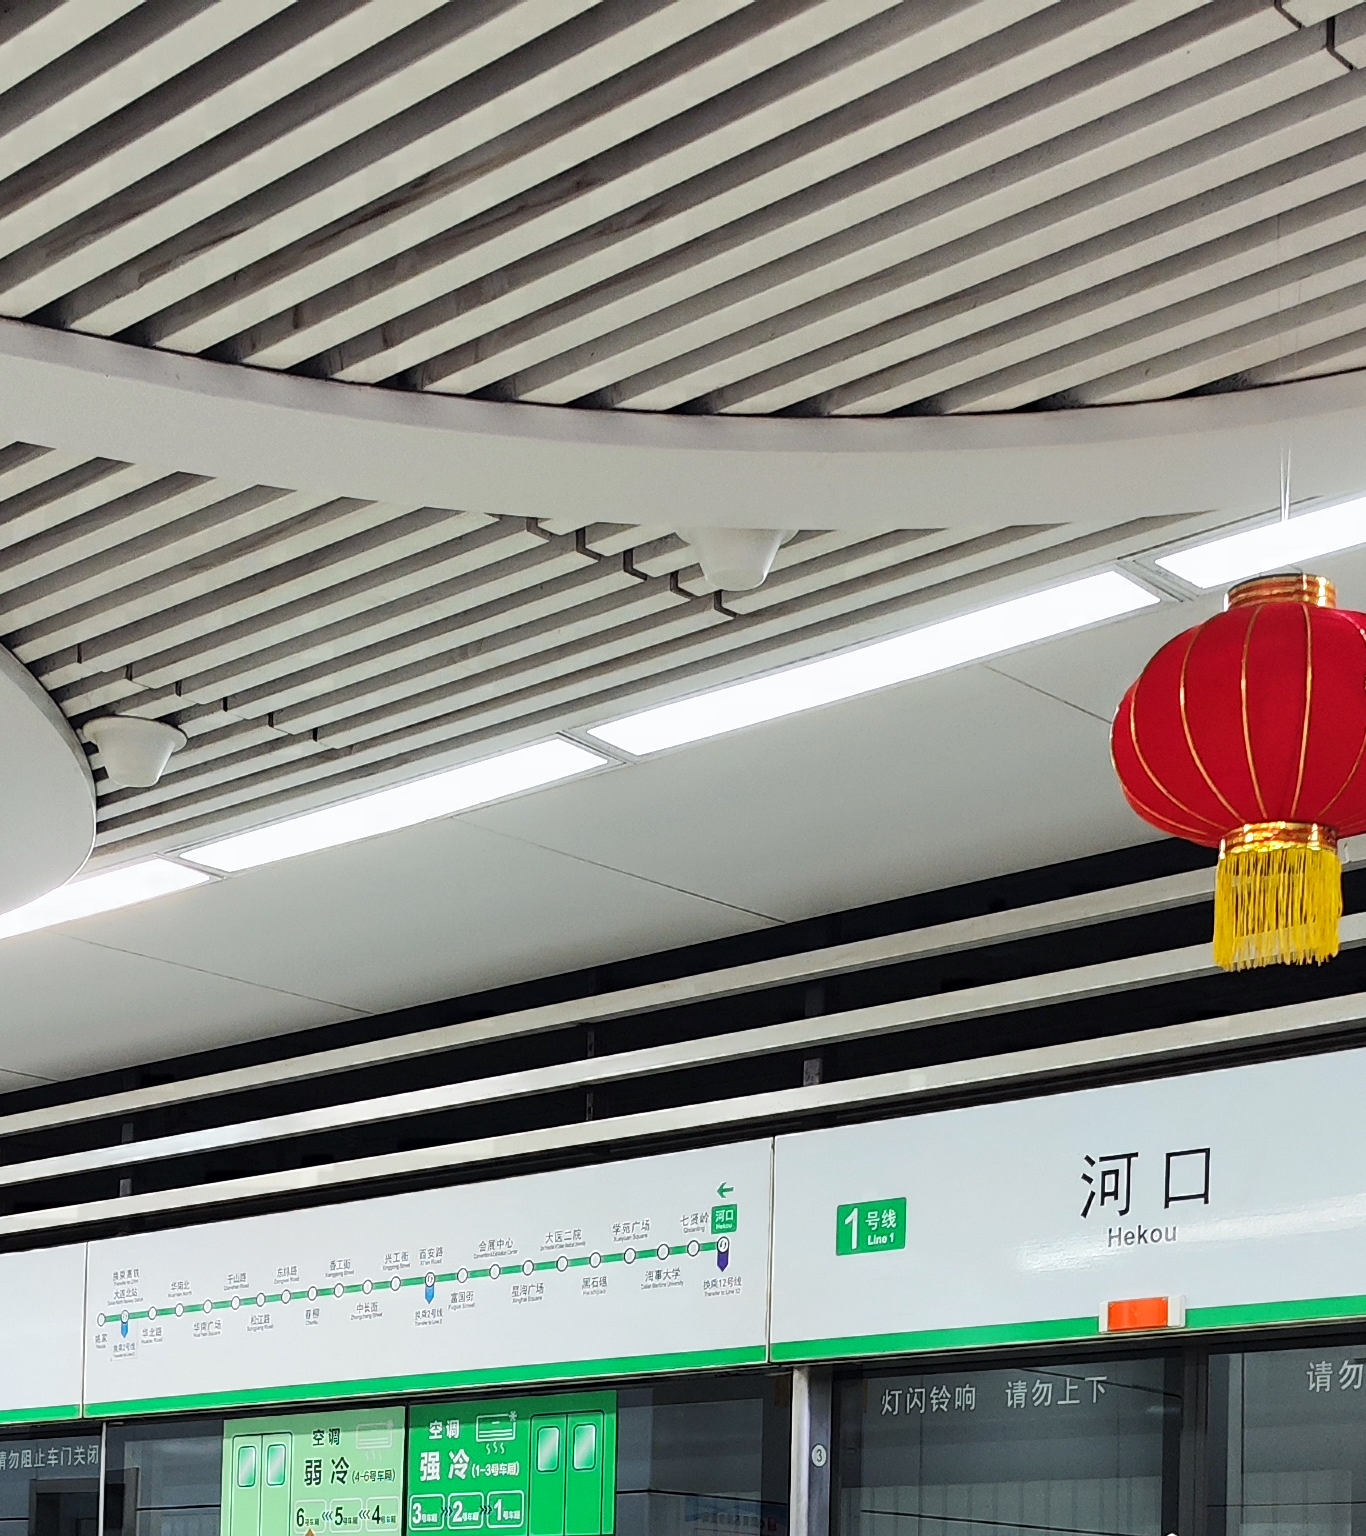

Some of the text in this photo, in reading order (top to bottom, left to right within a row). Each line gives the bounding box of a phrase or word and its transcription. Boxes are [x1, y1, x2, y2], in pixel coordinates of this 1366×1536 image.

[1081, 1148, 1210, 1218] 河口
[715, 1209, 734, 1222] 河口
[545, 1229, 582, 1244] 大医二院
[844, 1208, 897, 1249] 1号线
[868, 1232, 894, 1245] Line 1
[1108, 1225, 1176, 1247] Hekou
[478, 1237, 514, 1252] 会展中心
[881, 1376, 1108, 1415] 灯闪铃响 请勿上下
[312, 1428, 341, 1446] 空调
[429, 1419, 460, 1440] 空调
[304, 1456, 350, 1486] 弱冷
[420, 1449, 470, 1481] 强冷
